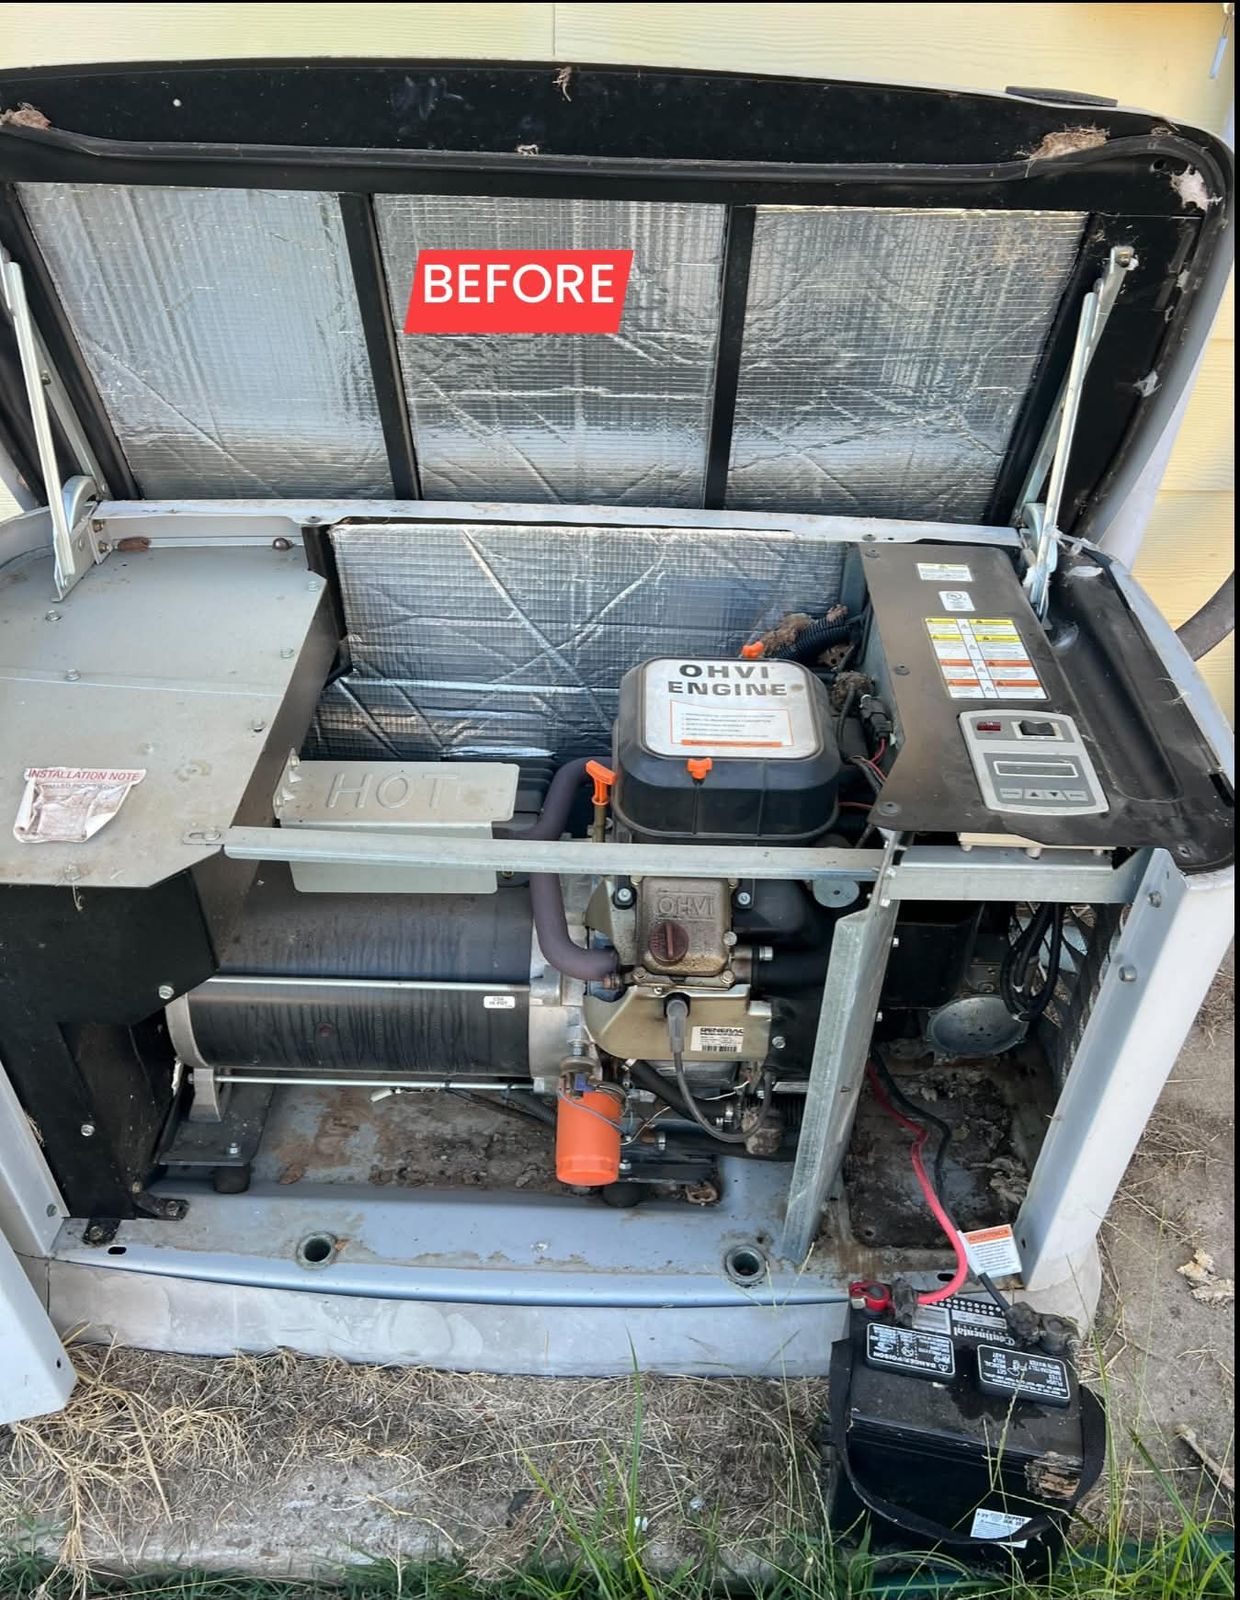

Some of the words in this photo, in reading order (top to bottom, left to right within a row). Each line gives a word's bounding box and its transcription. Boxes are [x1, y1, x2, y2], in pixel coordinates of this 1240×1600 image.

[679, 664, 769, 679] OHVI
[667, 680, 787, 696] ENGINE
[27, 768, 106, 780] INSTALLATION
[107, 771, 141, 781] NOTE
[325, 772, 460, 810] HOT
[657, 894, 715, 916] OHVI
[953, 1324, 1016, 1347] Continental
